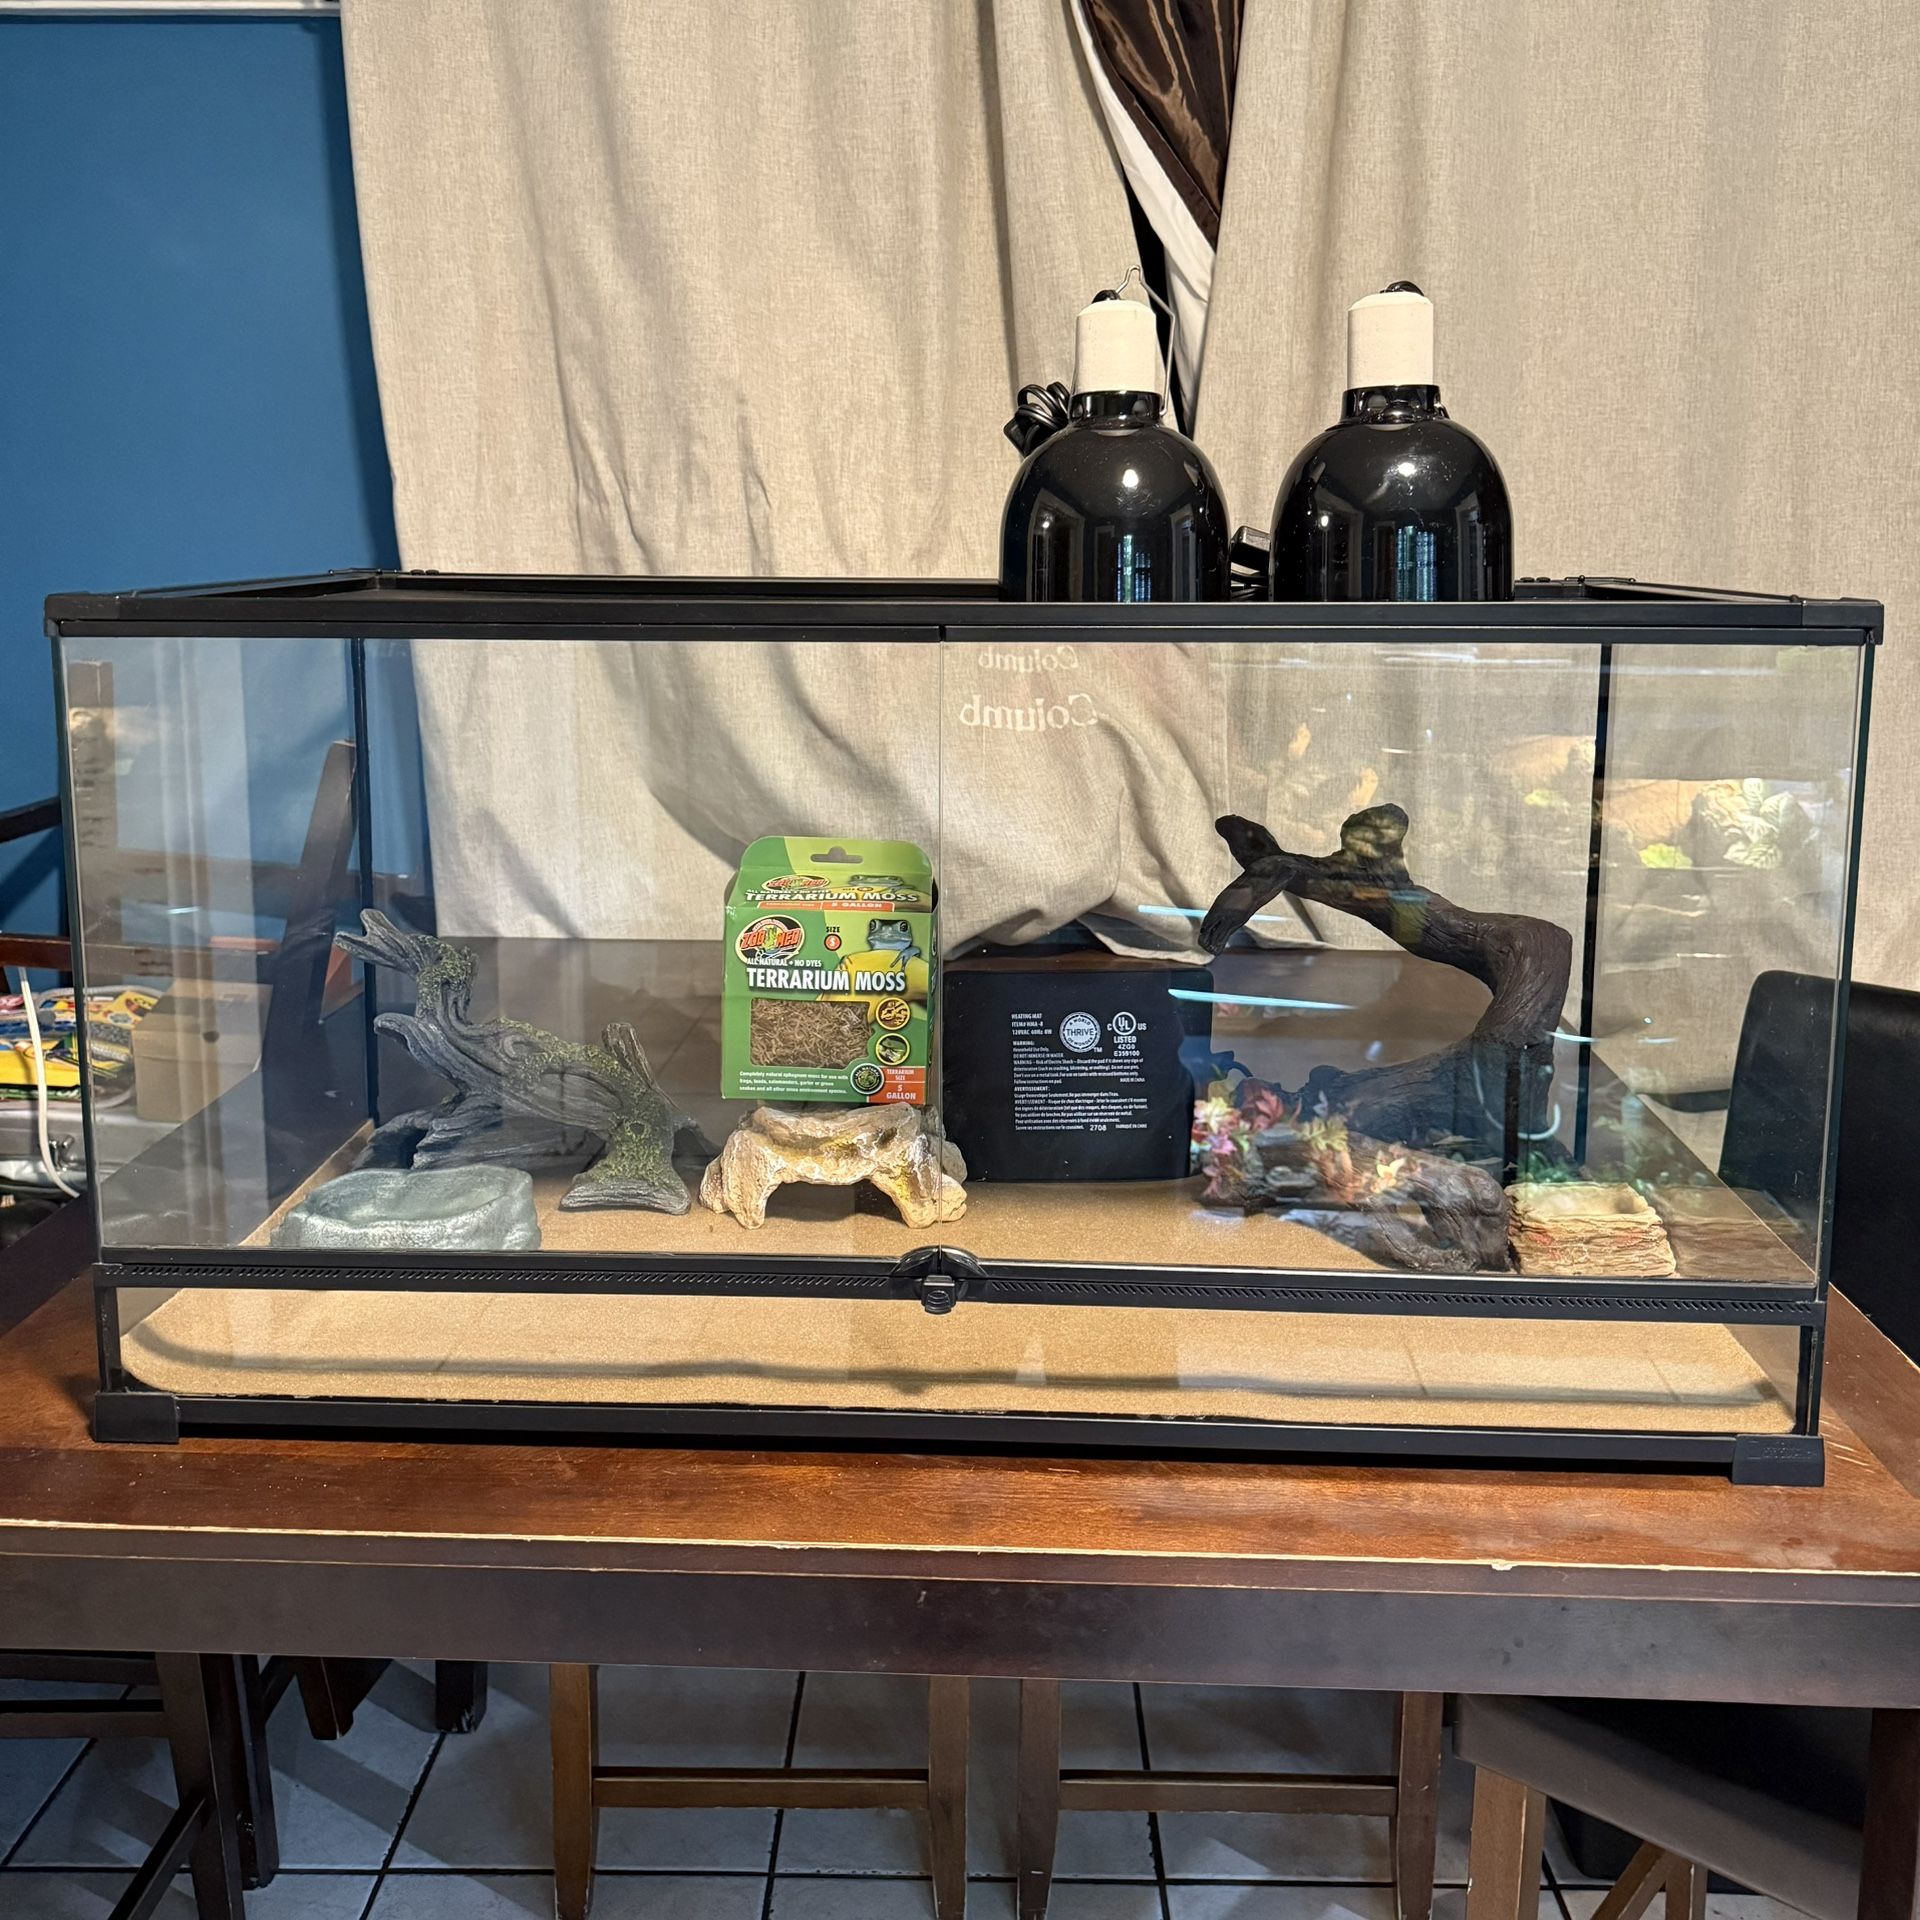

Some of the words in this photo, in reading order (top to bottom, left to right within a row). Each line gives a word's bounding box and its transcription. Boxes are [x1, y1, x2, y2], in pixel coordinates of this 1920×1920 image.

[744, 893, 857, 901] TERRARIUM
[862, 893, 918, 902] MOSS
[741, 931, 766, 949] ZOO
[746, 957, 758, 965] ALL
[758, 958, 788, 966] NATURAL
[805, 959, 823, 967] DYES
[746, 967, 850, 991] TERRARIUM
[855, 970, 906, 992] MOSS
[1137, 1023, 1147, 1031] US
[1065, 1029, 1095, 1037] THRIVE
[1113, 1036, 1137, 1044] LISTED
[886, 1092, 917, 1100] GALLON
